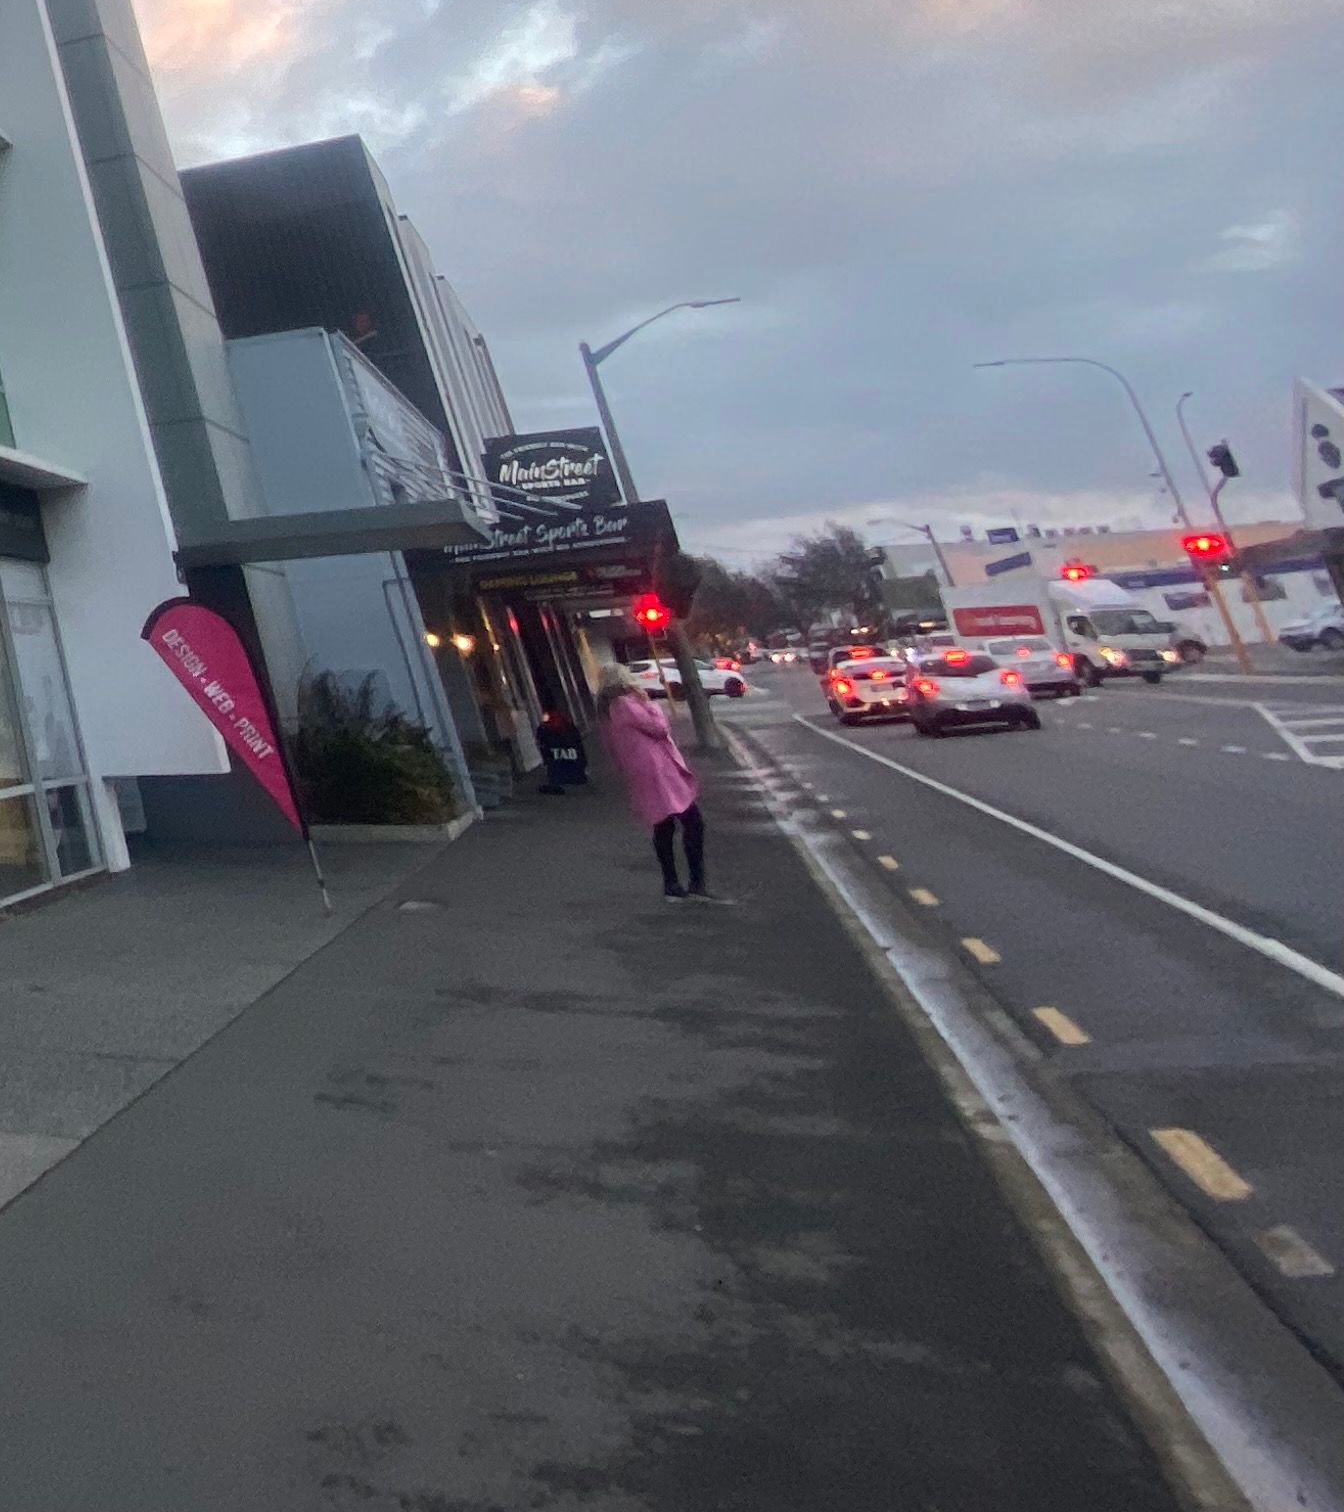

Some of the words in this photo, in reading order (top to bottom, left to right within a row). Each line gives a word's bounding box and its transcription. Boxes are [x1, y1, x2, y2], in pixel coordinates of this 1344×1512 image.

[593, 514, 628, 536] Bar
[162, 628, 208, 679] DESIGN
[204, 680, 236, 715] WEB
[233, 717, 275, 760] PRINT
